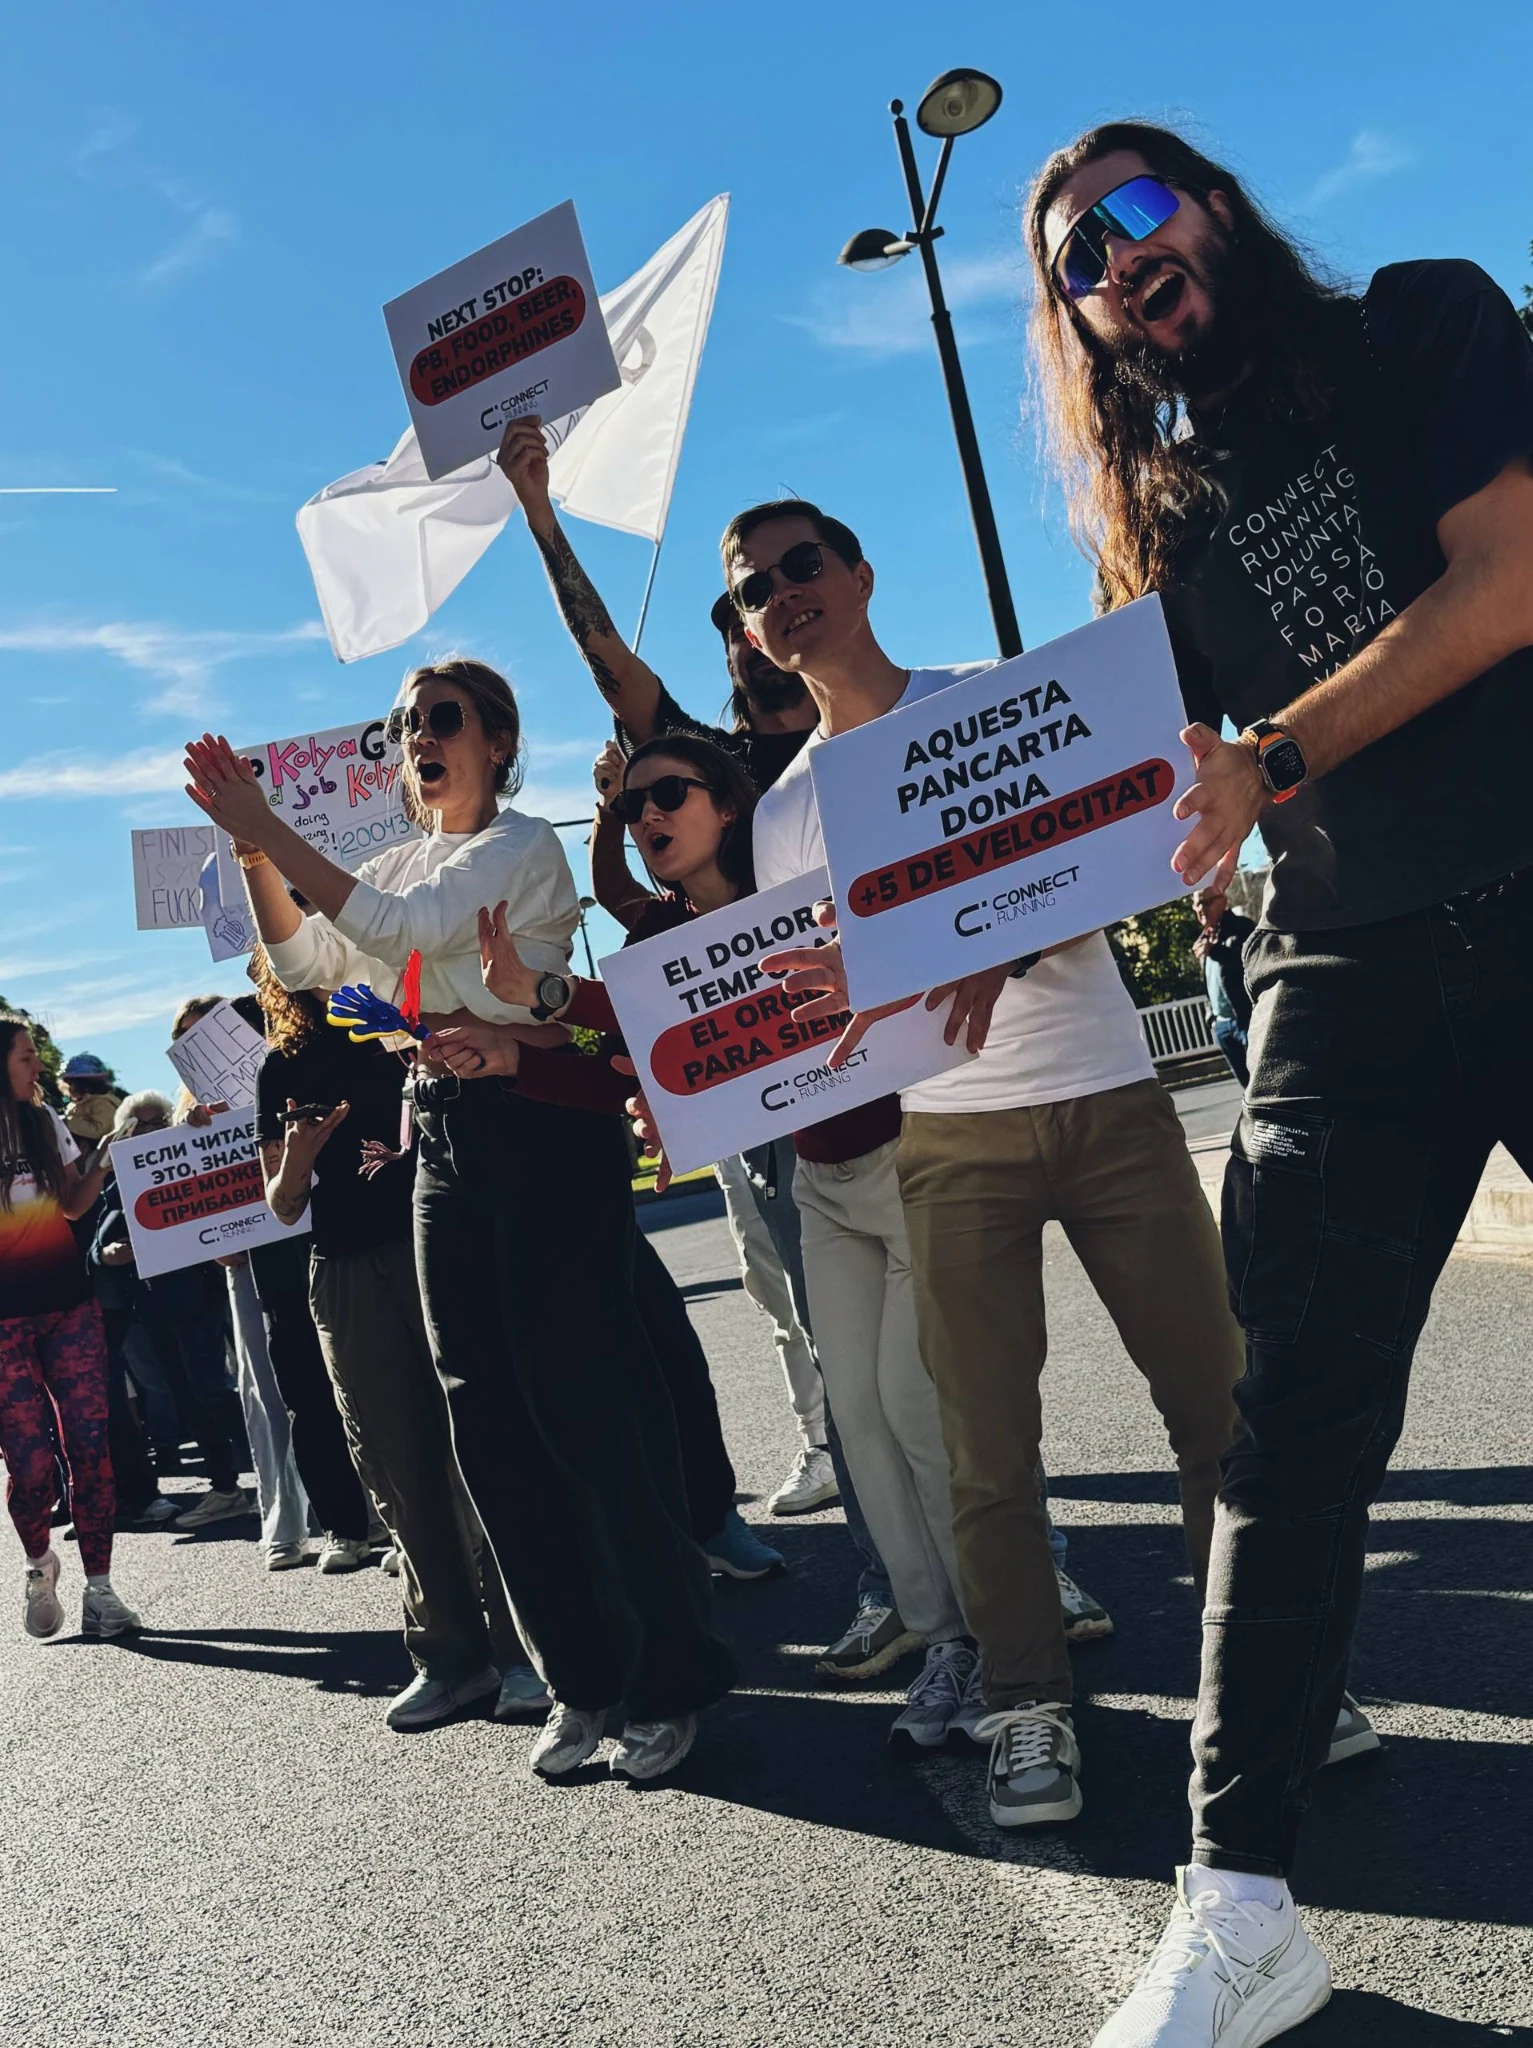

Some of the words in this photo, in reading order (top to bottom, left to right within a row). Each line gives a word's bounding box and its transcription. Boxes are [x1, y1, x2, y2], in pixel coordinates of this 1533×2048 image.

[427, 299, 477, 342] NEXT
[484, 267, 545, 311] STOP:
[416, 350, 449, 378] PB,
[451, 316, 516, 358] FOOD,
[519, 280, 578, 322] BEER,
[430, 309, 575, 399] ENDORPHINES
[500, 379, 549, 411] CONNECT
[504, 399, 539, 420] RUNNING
[1229, 444, 1336, 545] CONNECT
[1240, 468, 1355, 574] RUNNING
[1255, 504, 1358, 596] VOLUNTA
[903, 679, 1072, 773] AQUESTA
[267, 737, 357, 787] Kolya
[896, 713, 1092, 814] PANCARTA
[292, 776, 337, 809] job
[940, 774, 1050, 837] DONA
[294, 813, 330, 828] doing
[341, 813, 411, 854] 20043
[860, 872, 899, 907] +5
[907, 851, 955, 892] DE
[961, 765, 1160, 867] VELOCITAT
[992, 866, 1080, 911] CONNECT
[996, 892, 1056, 925] RUNNING
[662, 956, 702, 987] EL
[705, 906, 819, 970] DOLOR
[690, 1017, 729, 1049] EL
[682, 1037, 773, 1089] PARA
[799, 1071, 851, 1100] RUNNING
[133, 1143, 188, 1170] ЕСЛИ
[151, 1163, 198, 1185] ЭТО,
[146, 1182, 194, 1208] ЕЩЕ
[162, 1183, 264, 1224] ПРИБАВИ
[220, 1212, 267, 1233] CONNECT
